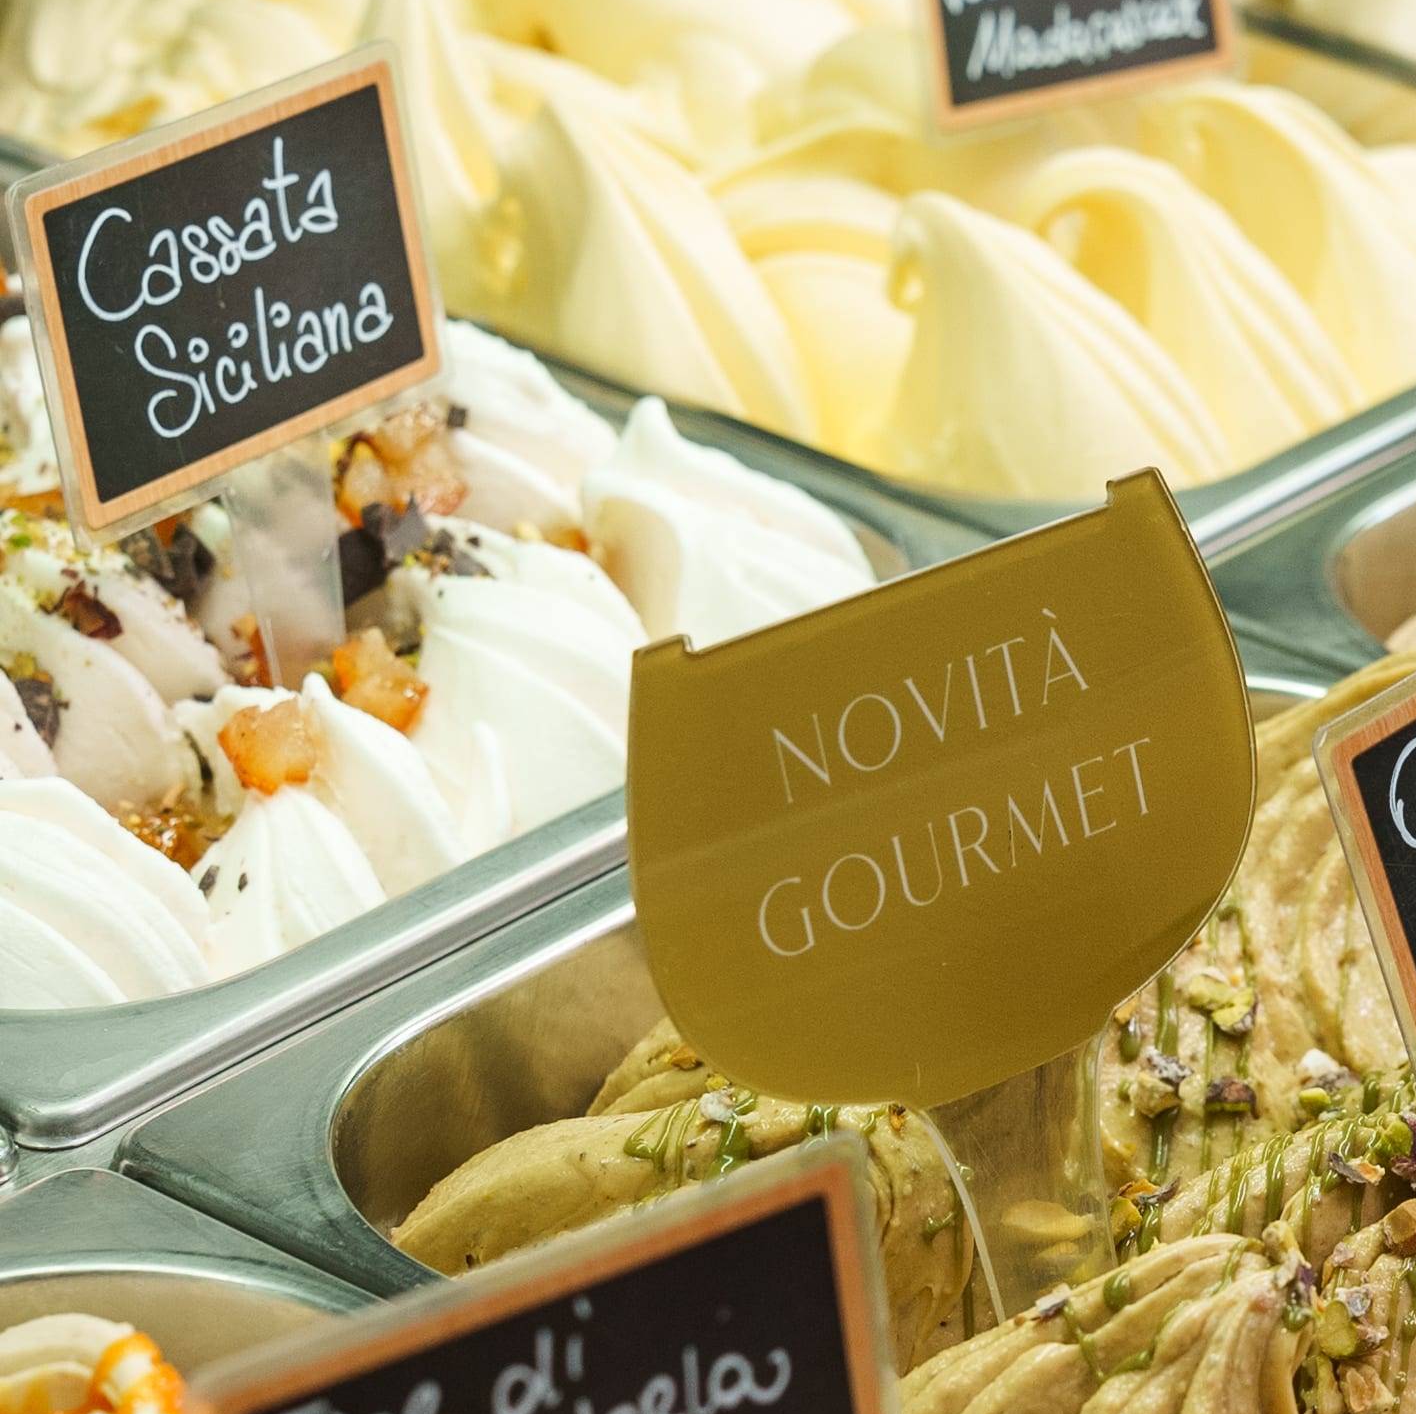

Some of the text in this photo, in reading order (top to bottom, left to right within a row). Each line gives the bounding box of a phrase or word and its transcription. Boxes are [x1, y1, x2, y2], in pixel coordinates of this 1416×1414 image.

[77, 135, 338, 322] Cassata
[134, 282, 394, 439] Siciliana
[772, 606, 1090, 804] NOVITÀ
[758, 737, 1152, 957] GOURMET
